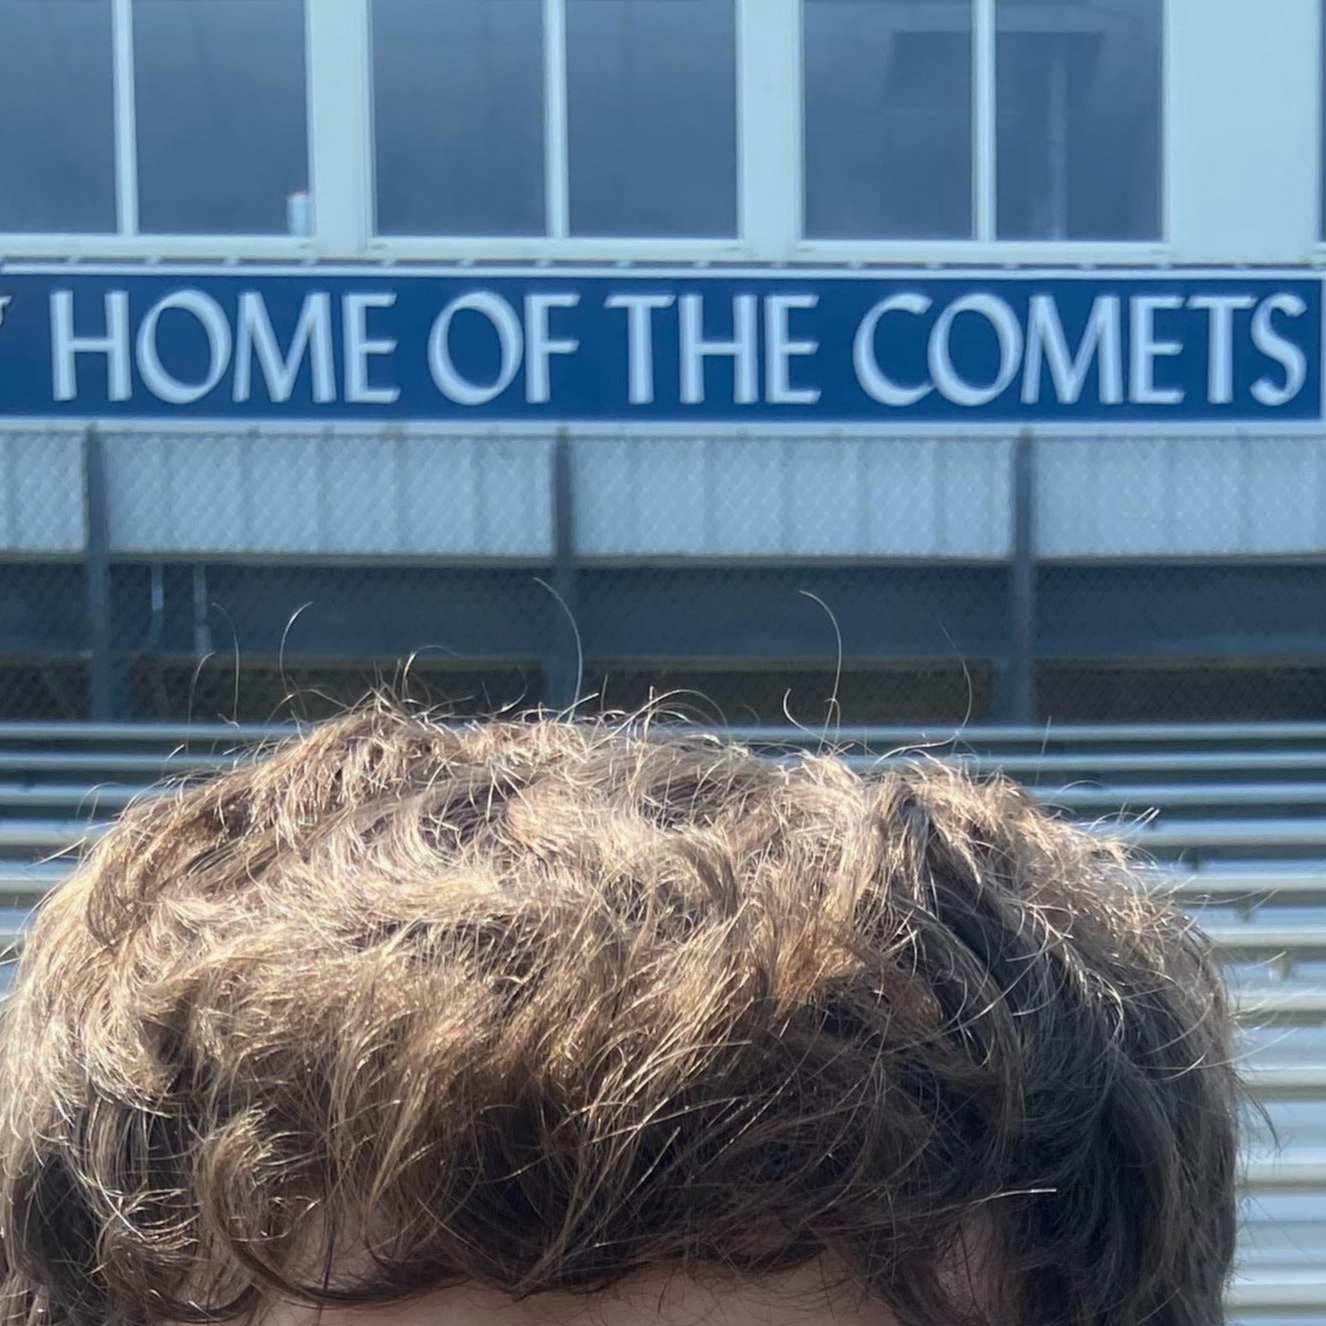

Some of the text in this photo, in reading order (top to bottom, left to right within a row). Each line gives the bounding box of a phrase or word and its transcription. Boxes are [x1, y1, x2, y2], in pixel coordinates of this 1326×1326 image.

[49, 289, 1308, 407] HOME OF THE COMETS
